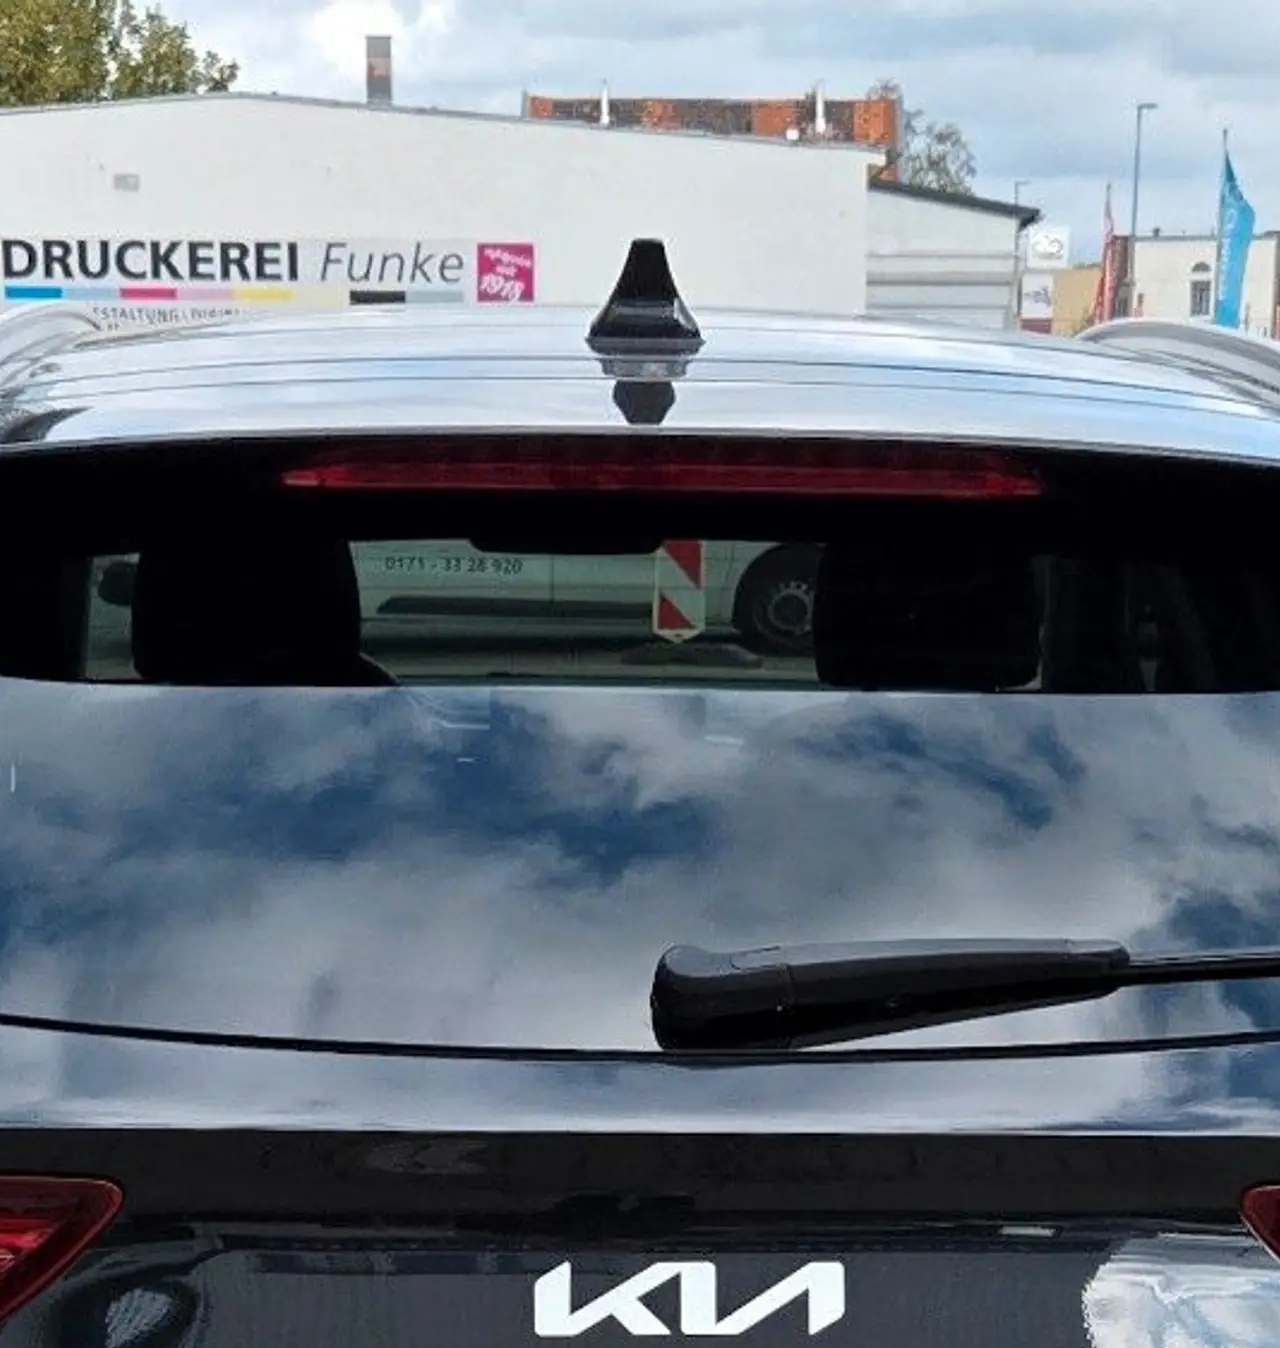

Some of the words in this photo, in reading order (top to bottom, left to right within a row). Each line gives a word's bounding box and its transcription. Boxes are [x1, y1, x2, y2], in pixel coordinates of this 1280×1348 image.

[1, 240, 298, 281] DRUCKEREI
[321, 242, 464, 284] Funke
[533, 1261, 846, 1337] KIA
